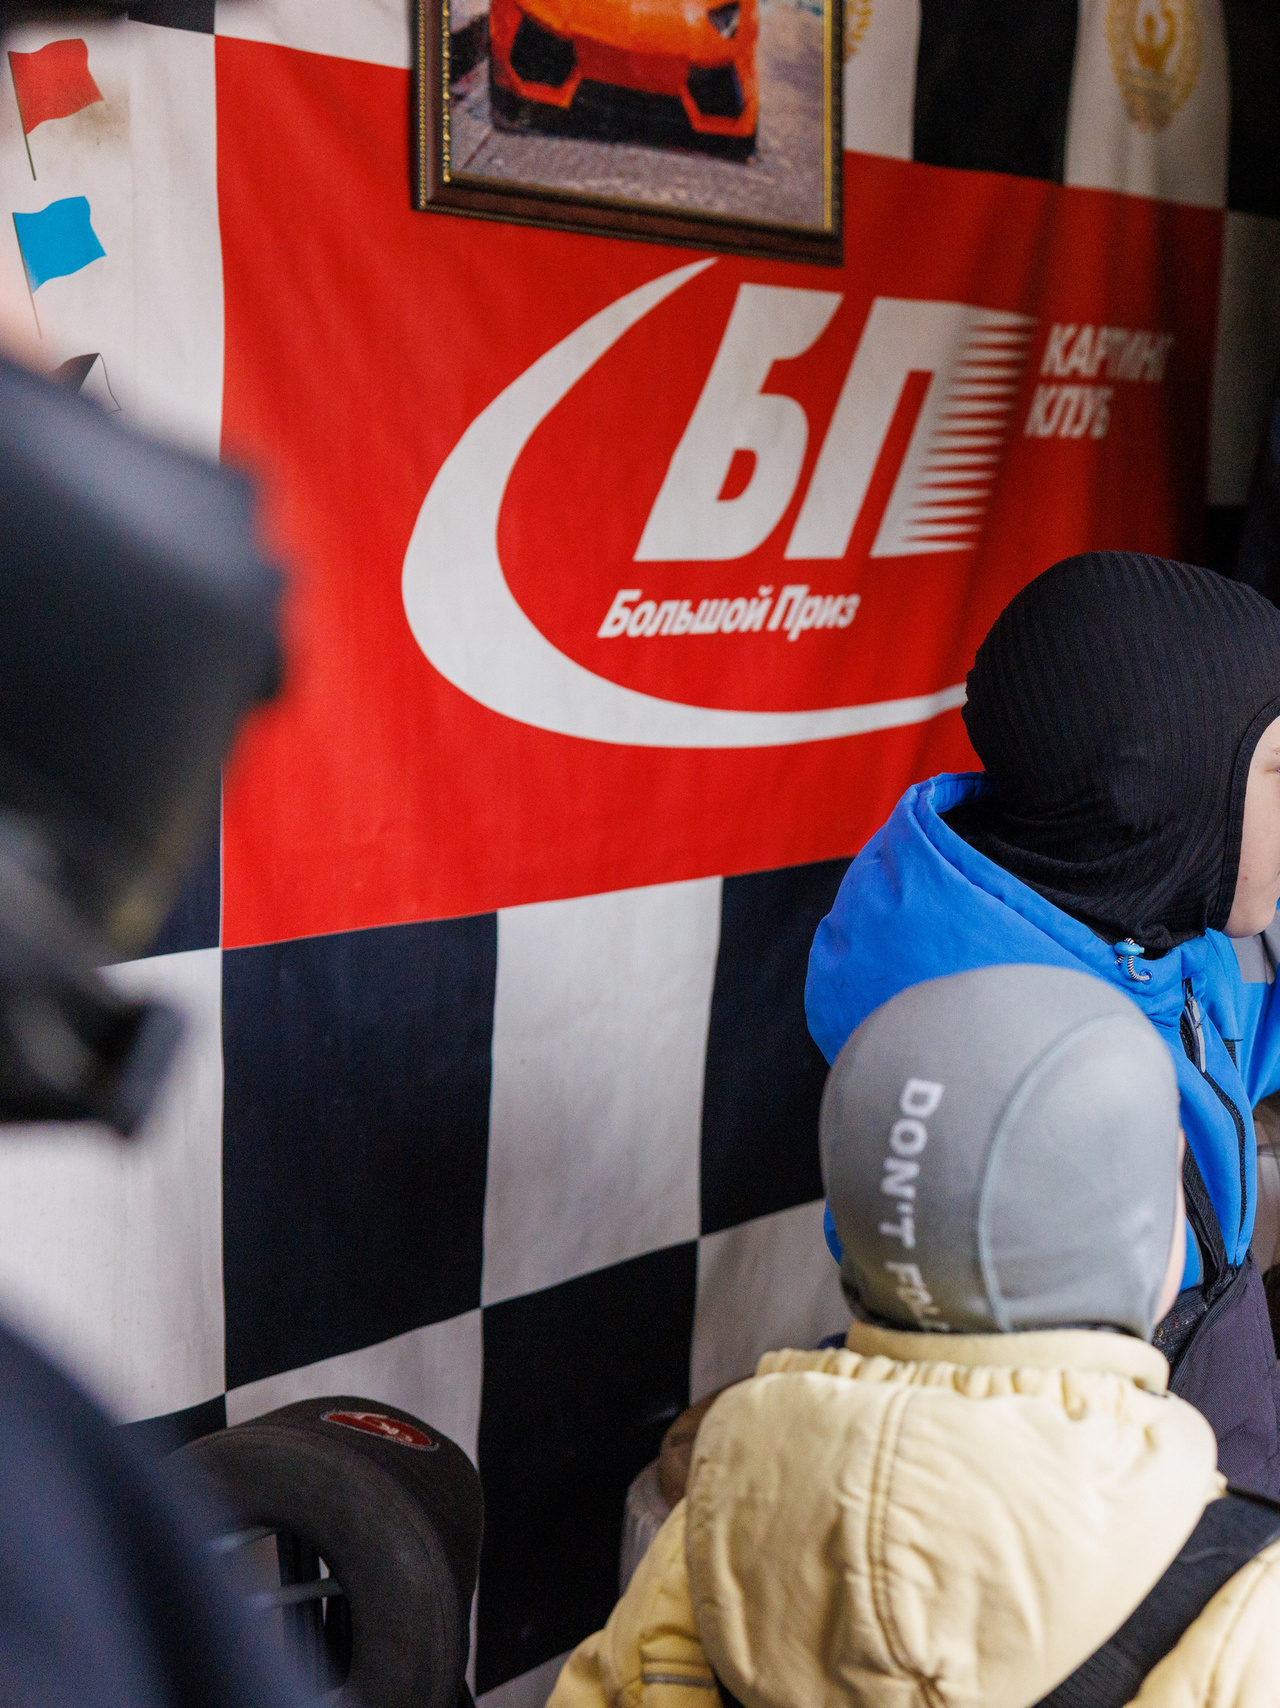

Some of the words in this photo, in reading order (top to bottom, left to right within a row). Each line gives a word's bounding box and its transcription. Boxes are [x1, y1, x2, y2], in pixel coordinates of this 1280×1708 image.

[633, 282, 1038, 562] БП
[1022, 384, 1115, 440] КЛУБ
[597, 584, 774, 638] Большой
[766, 584, 861, 642] Приз
[878, 1076, 945, 1250] DON'T
